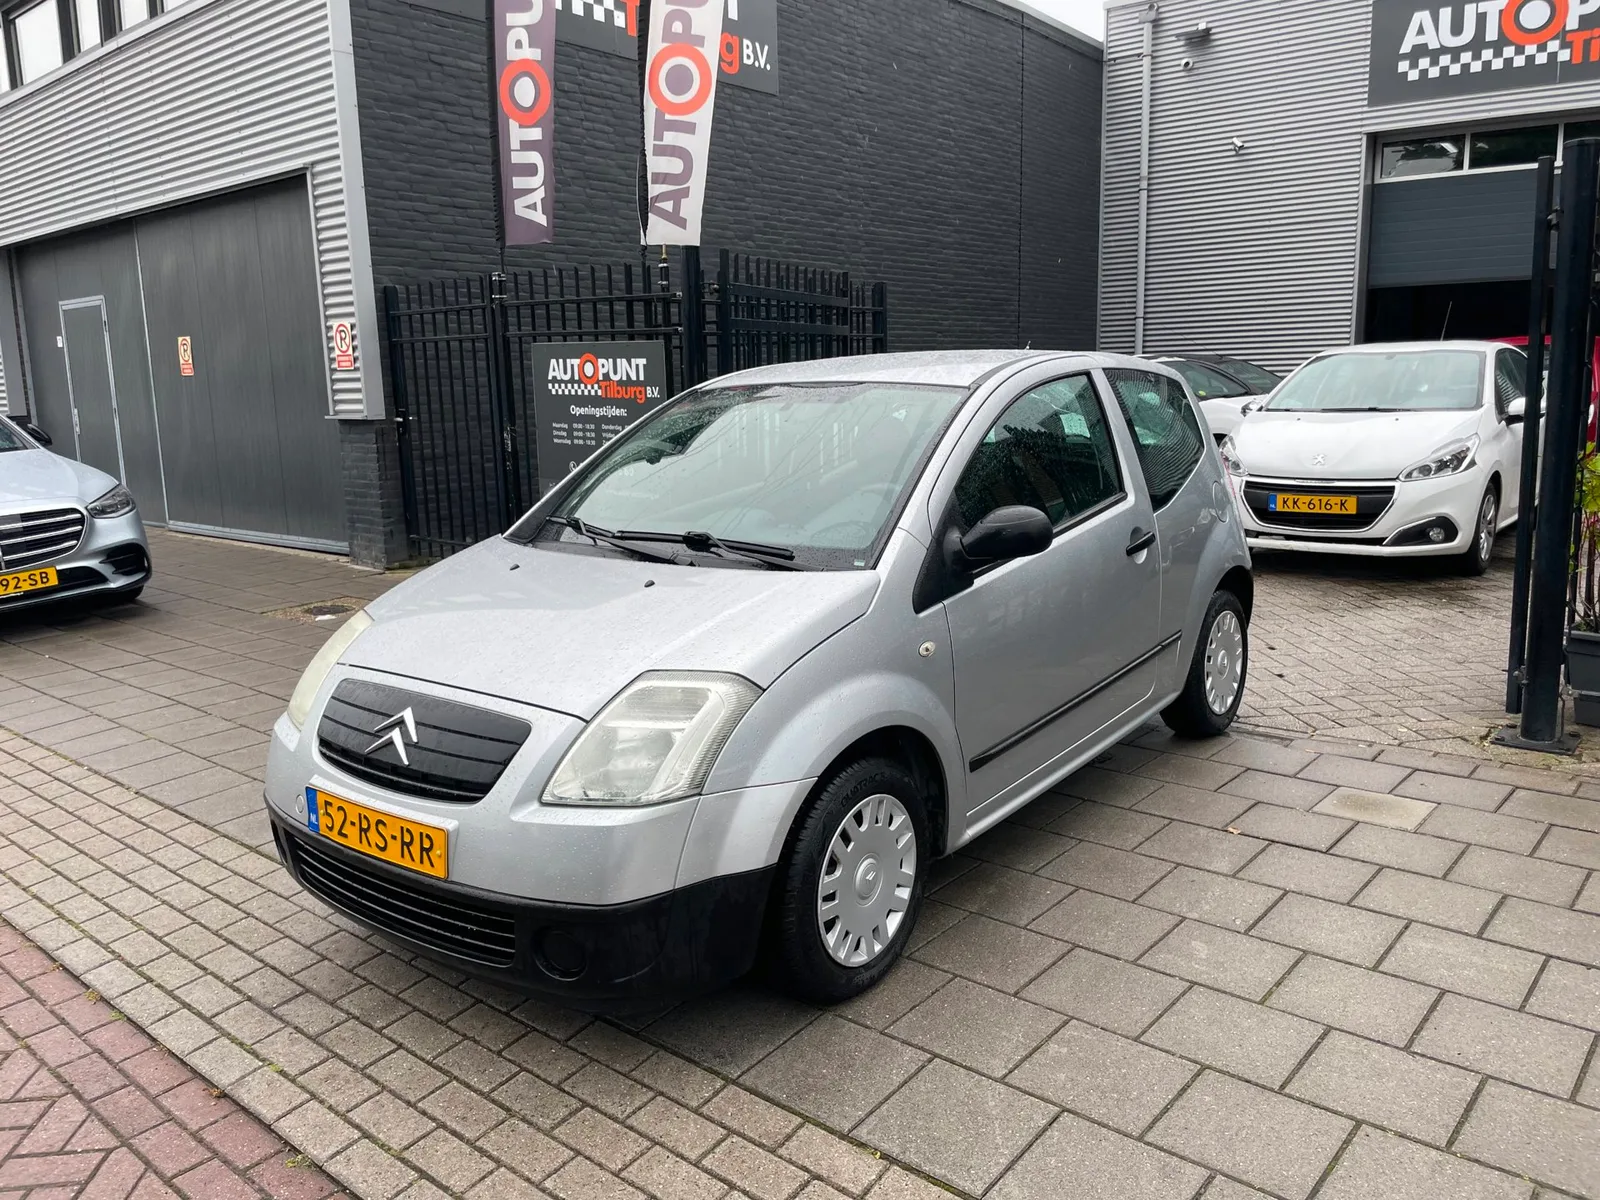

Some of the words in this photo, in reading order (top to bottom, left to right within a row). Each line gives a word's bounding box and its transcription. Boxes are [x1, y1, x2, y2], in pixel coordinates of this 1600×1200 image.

[742, 38, 771, 71] B.V.
[648, 0, 713, 230] AUTOP
[548, 353, 647, 385] AUTOPUNT
[599, 381, 646, 404] Tilburg
[646, 387, 660, 398] B.V.
[570, 405, 628, 418] Openingstijden:
[1282, 497, 1349, 511] KK-616-K
[0, 572, 50, 591] 92-SB
[310, 813, 318, 824] NL
[323, 800, 435, 868] 52-RS-RR
